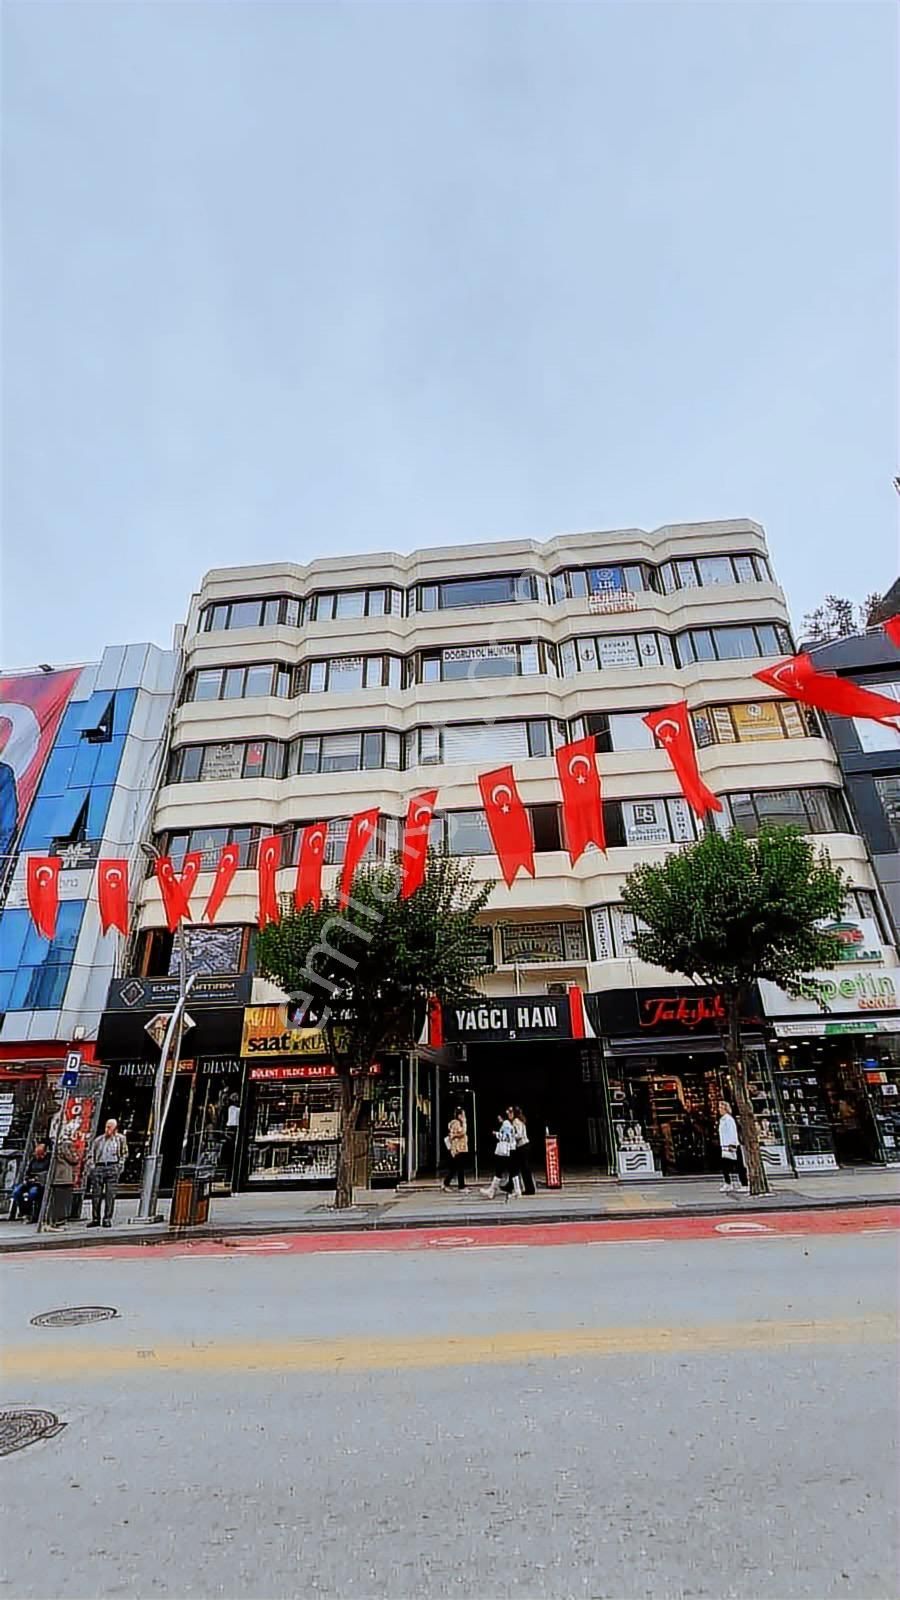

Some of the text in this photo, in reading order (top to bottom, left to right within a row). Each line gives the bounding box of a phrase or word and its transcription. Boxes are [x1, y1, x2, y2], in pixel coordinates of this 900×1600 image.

[455, 1005, 558, 1030] YAĞCI HAN
[247, 1030, 292, 1052] saat
[509, 1030, 516, 1039] 5
[69, 1056, 79, 1069] D
[202, 1059, 241, 1074] DİLVİN
